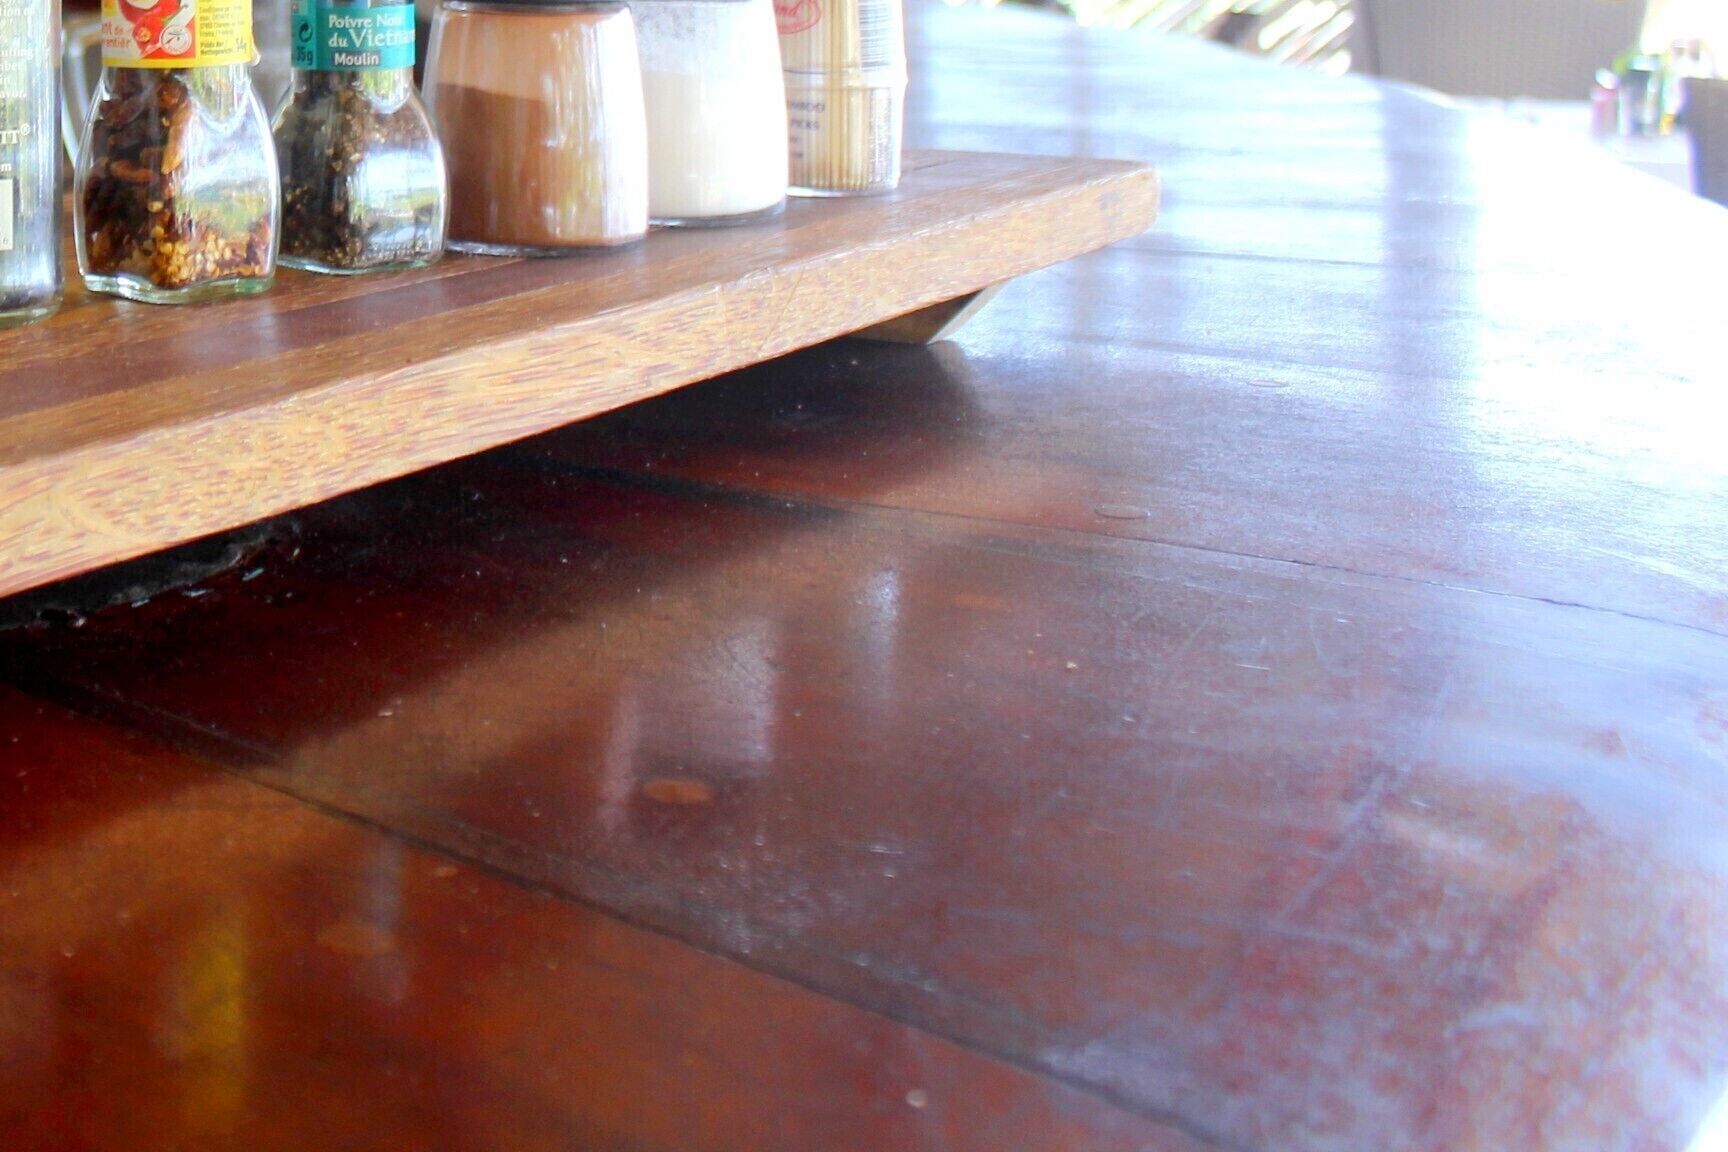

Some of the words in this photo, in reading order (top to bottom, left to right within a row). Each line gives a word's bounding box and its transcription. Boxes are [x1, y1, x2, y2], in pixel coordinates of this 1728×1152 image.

[328, 13, 373, 29] Poivre
[328, 32, 349, 48] du
[334, 51, 380, 66] Moulin
